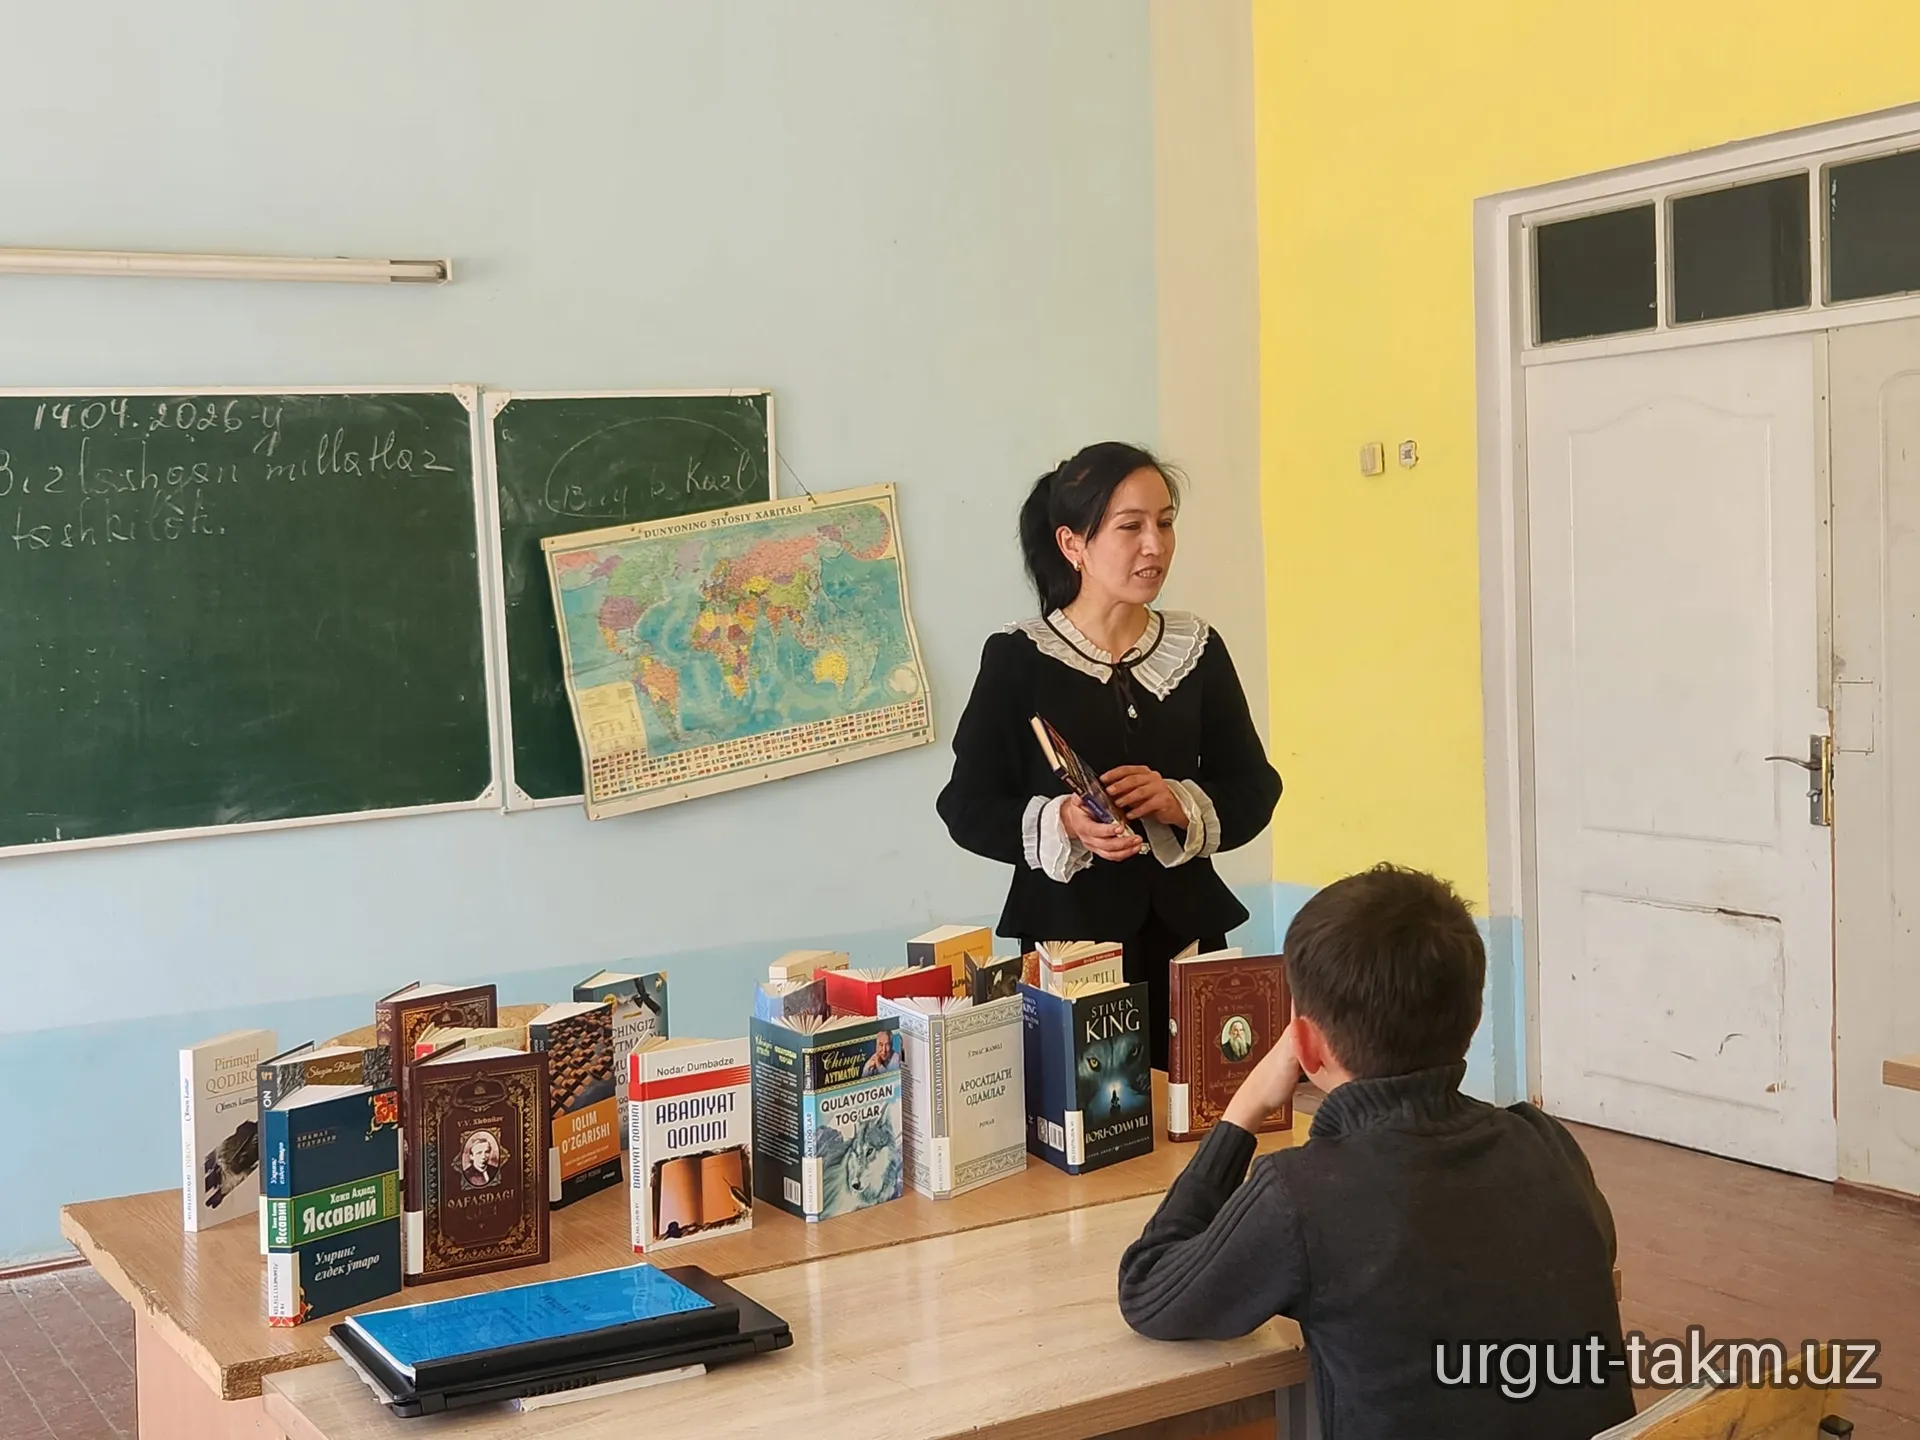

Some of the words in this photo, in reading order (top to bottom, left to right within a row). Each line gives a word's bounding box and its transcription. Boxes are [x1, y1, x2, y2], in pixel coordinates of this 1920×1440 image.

[644, 520, 707, 539] DUNYONING
[711, 513, 751, 527] SIYOSIY
[755, 504, 802, 520] XARITASI
[1091, 997, 1134, 1019] STIVEN
[1085, 1008, 1141, 1043] KING
[214, 1048, 260, 1071] Pirimqul
[656, 1066, 686, 1078] Nodar
[687, 1057, 734, 1072] Dumbadze
[821, 1048, 867, 1070] Chingiz
[206, 1067, 258, 1094] QODIRO
[824, 1066, 860, 1085] AYTMATOV
[959, 1068, 1012, 1094] АРОСАТДАГИ
[656, 1091, 737, 1125] ABADIYAT
[821, 1084, 893, 1111] QULAYOTGAN
[966, 1085, 1006, 1107] ОДАМЛАР
[571, 1111, 598, 1133] IQLIM
[667, 1119, 727, 1149] QONUNI
[561, 1122, 611, 1154] O'ZGARISHI
[276, 1202, 287, 1244] Яссавий
[302, 1196, 377, 1235] Яссавий
[314, 1264, 345, 1281] елдек
[345, 1253, 380, 1275] ўтаро
[315, 1245, 357, 1265] Умринг
